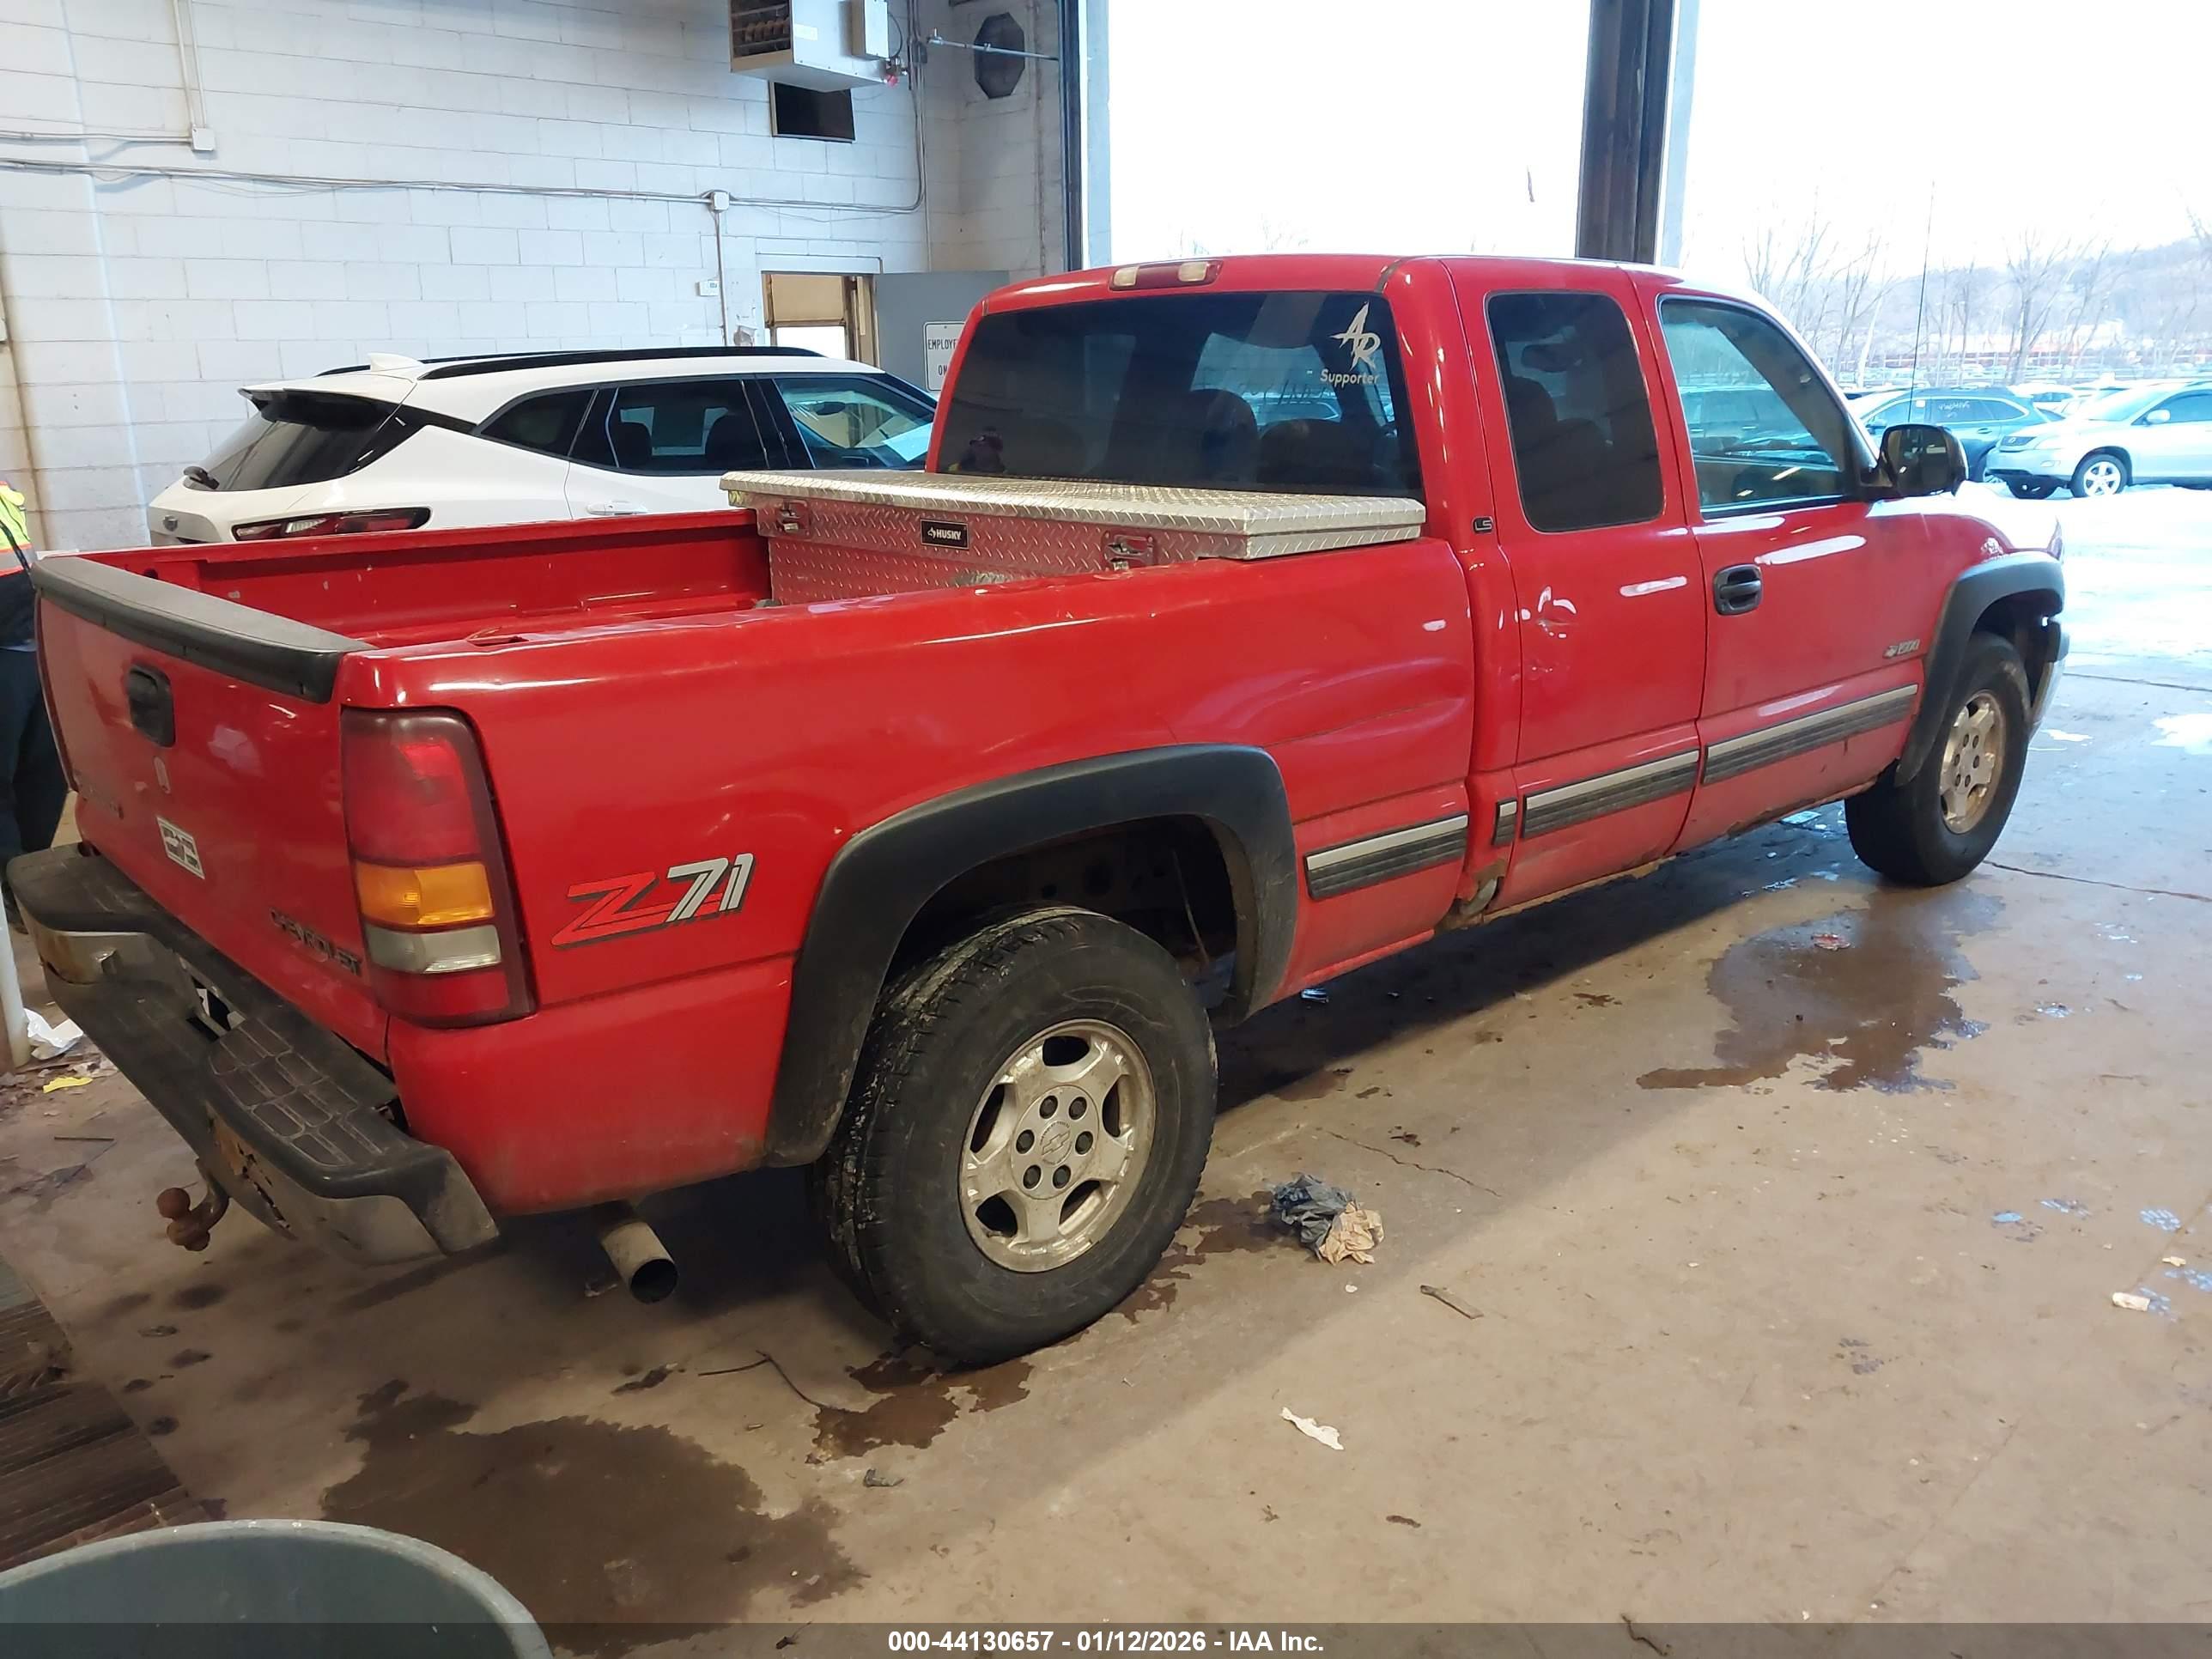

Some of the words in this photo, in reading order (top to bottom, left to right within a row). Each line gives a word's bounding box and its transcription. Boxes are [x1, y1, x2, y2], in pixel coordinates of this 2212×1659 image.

[927, 338, 958, 349] EMPLOYE
[1320, 368, 1380, 387] Supporter
[1474, 520, 1492, 532] LS
[936, 529, 962, 540] HUSKY
[550, 851, 756, 948] Z71
